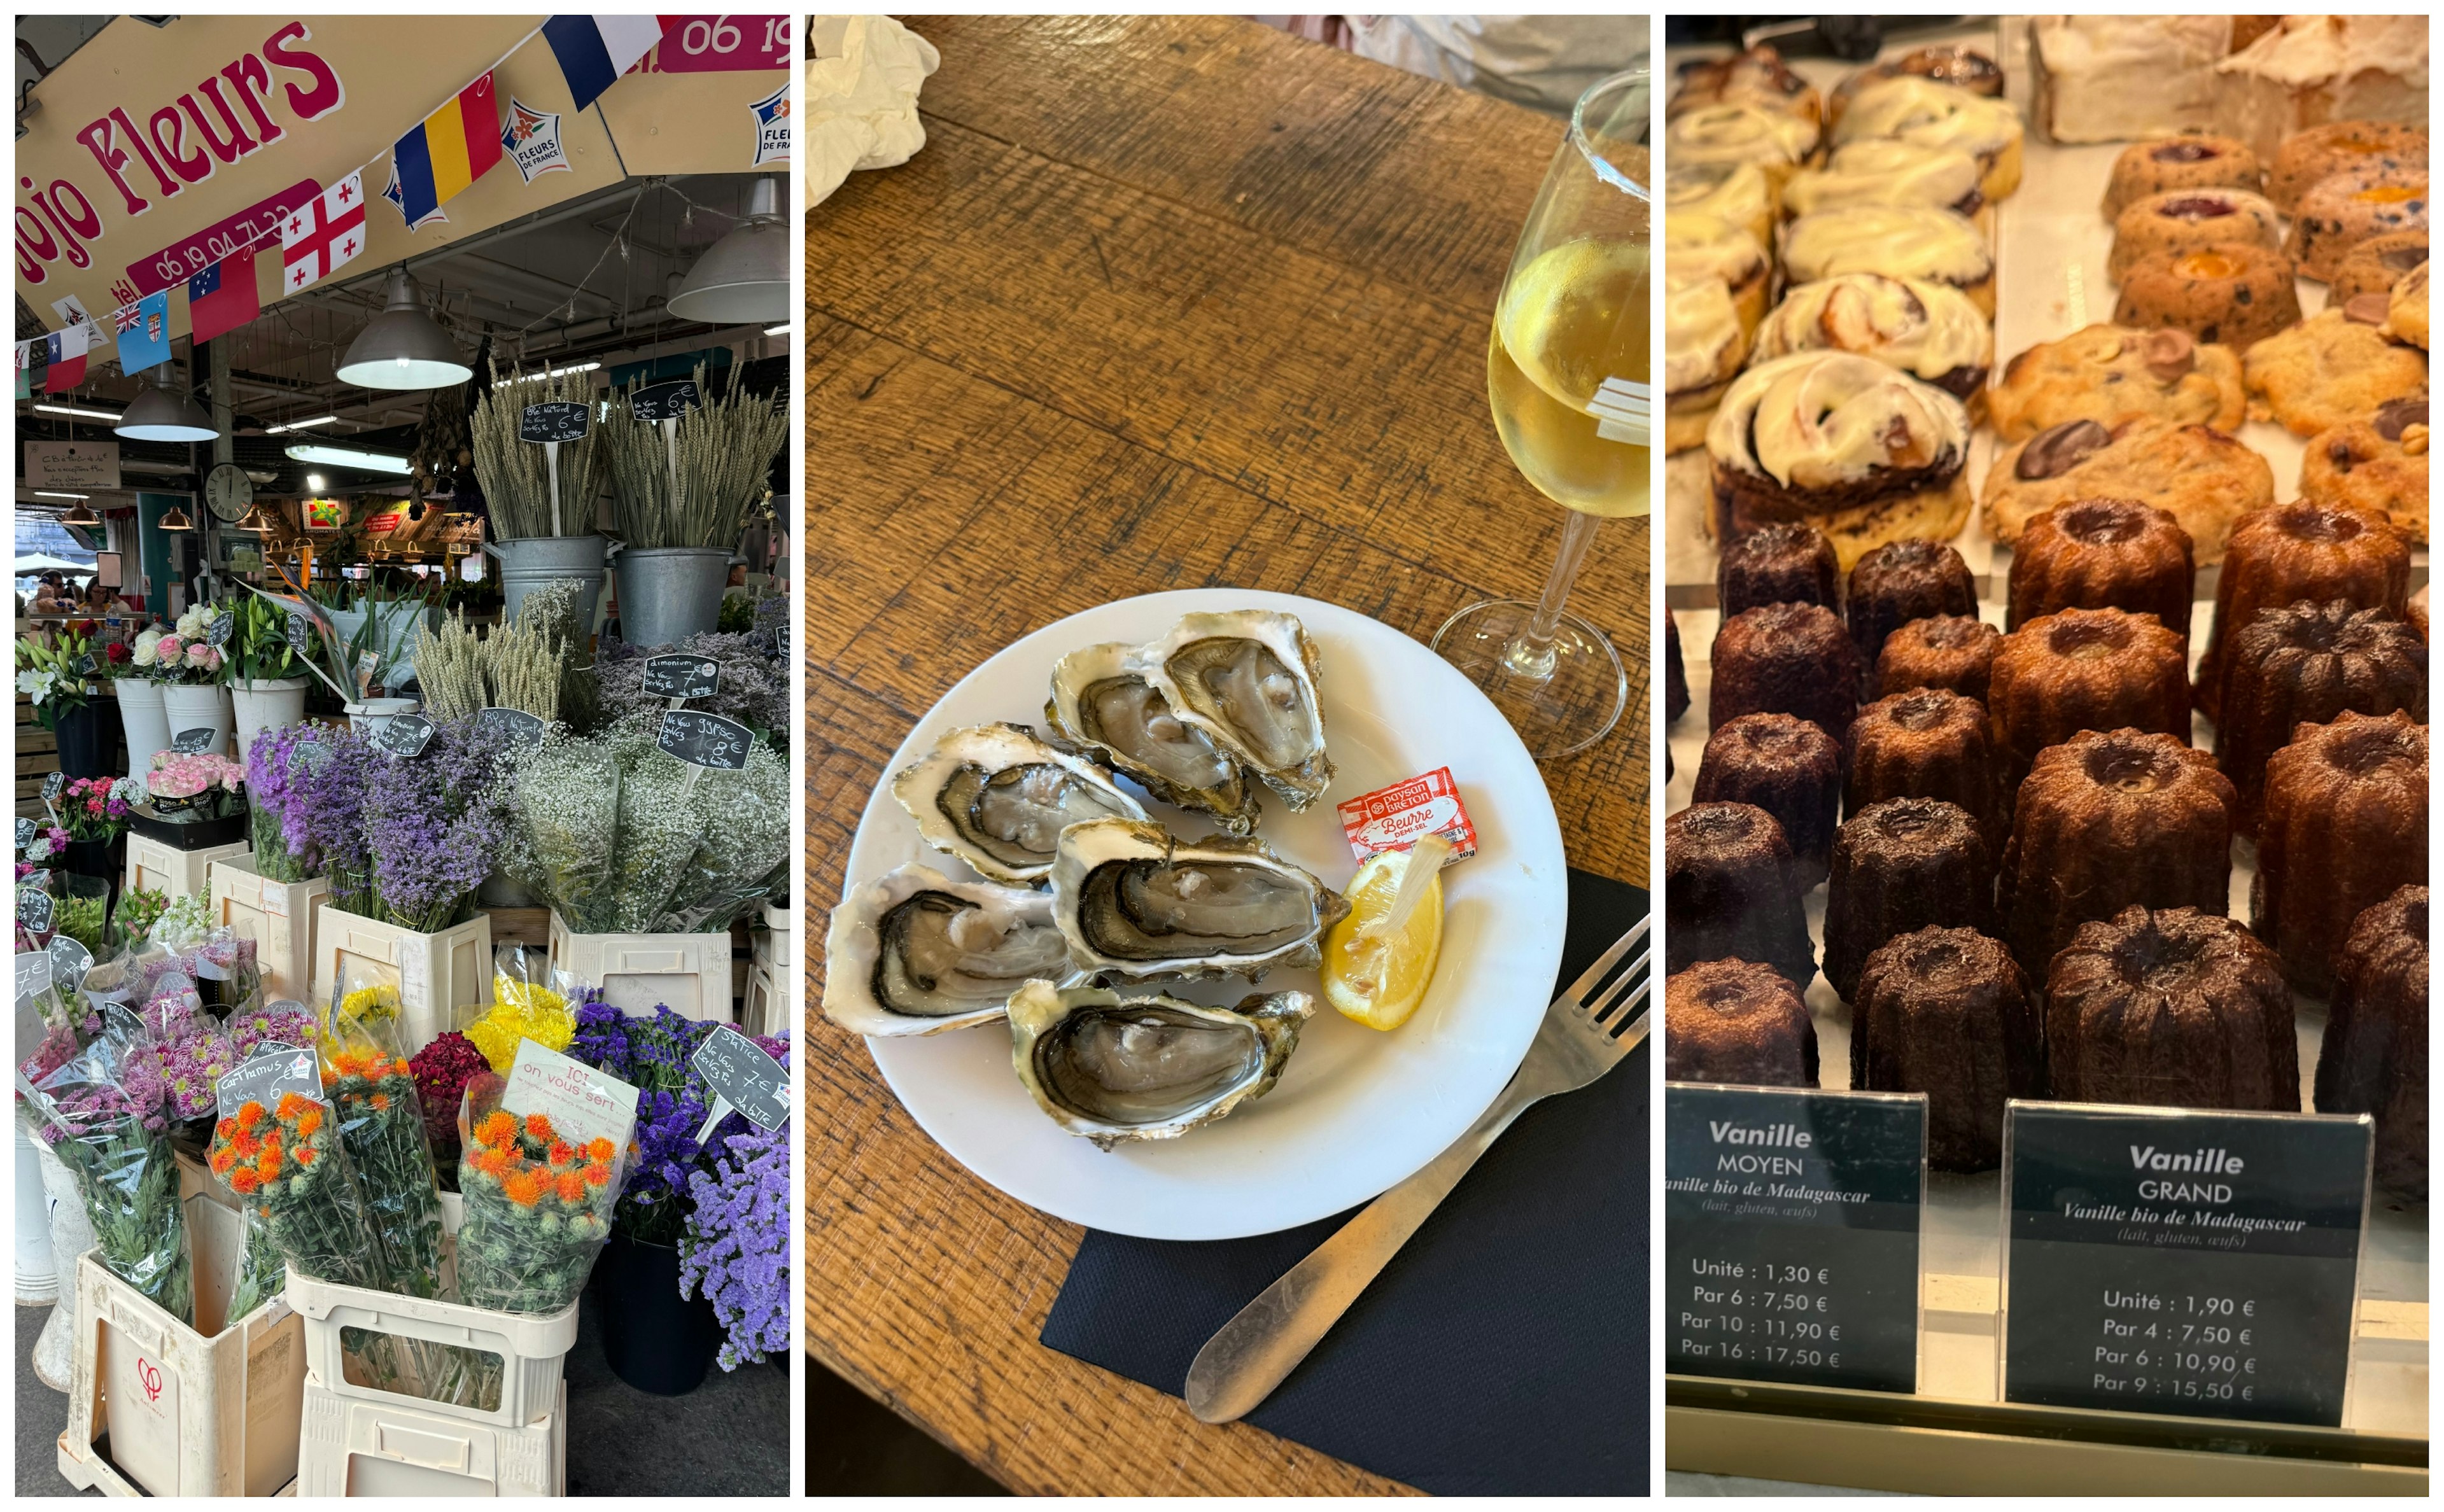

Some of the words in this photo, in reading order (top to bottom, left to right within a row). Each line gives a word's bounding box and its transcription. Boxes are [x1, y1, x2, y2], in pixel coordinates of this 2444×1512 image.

[682, 15, 741, 55] 06
[76, 21, 345, 216] Fleurs
[518, 139, 555, 162] FLEURS
[523, 160, 532, 169] DE
[533, 150, 559, 165] FRANCE
[156, 250, 183, 281] 06
[185, 246, 207, 269] 19
[677, 717, 691, 727] Vous
[1383, 783, 1426, 805] paysan
[1387, 792, 1429, 813] BRETON
[1381, 808, 1434, 834] Beurre
[1394, 823, 1428, 838] DEMI-SEL
[1459, 850, 1475, 858] 10g
[705, 1040, 717, 1056] Ne
[718, 1053, 734, 1073] Vous
[721, 1031, 760, 1064] Statice
[524, 1063, 541, 1077] on
[548, 1074, 580, 1095] vous
[566, 1066, 589, 1086] ICI
[234, 1089, 256, 1101] Vous
[1709, 1120, 1813, 1149] Vanille
[1717, 1154, 1803, 1176] MOYEN
[2130, 1145, 2244, 1175] Vanille
[1665, 1177, 1708, 1193] anille
[1713, 1179, 1738, 1195] bio
[1743, 1181, 1762, 1197] de
[1766, 1184, 1871, 1204] Madagascar
[2138, 1180, 2233, 1204] GRAND
[2063, 1202, 2126, 1221] Vanille
[2131, 1207, 2160, 1224] bio
[2164, 1209, 2186, 1226] de
[2190, 1210, 2307, 1233] Madagascar
[1692, 1258, 1745, 1278] Unité
[1766, 1264, 1811, 1284] 1,30
[1817, 1269, 1829, 1284] €
[1694, 1286, 1725, 1303] Par
[1731, 1289, 1743, 1306] 6
[1764, 1292, 1809, 1312] 7,50
[1816, 1297, 1828, 1312] €
[2103, 1290, 2161, 1311] Unité
[2186, 1296, 2234, 1317] 1,90
[2242, 1300, 2255, 1317] €
[1681, 1312, 1712, 1329] Par
[1720, 1315, 1743, 1333] 10
[1766, 1319, 1822, 1340] 11,90
[1829, 1326, 1840, 1341] €
[2103, 1319, 2137, 1338] Par
[2144, 1322, 2158, 1339] 4
[2181, 1324, 2231, 1345] 7,50
[2239, 1329, 2251, 1345] €
[1681, 1339, 1712, 1357] Par
[1720, 1343, 1743, 1359] 16
[1766, 1347, 1822, 1367] 17,50
[1829, 1353, 1840, 1368] €
[2095, 1347, 2129, 1365] Par
[2135, 1350, 2149, 1367] 6
[2174, 1352, 2236, 1373] 10,90
[2244, 1358, 2256, 1374] €
[2093, 1374, 2128, 1392] Par
[2133, 1377, 2147, 1394] 9
[2172, 1380, 2233, 1401] 15,50
[2242, 1385, 2254, 1401] €
